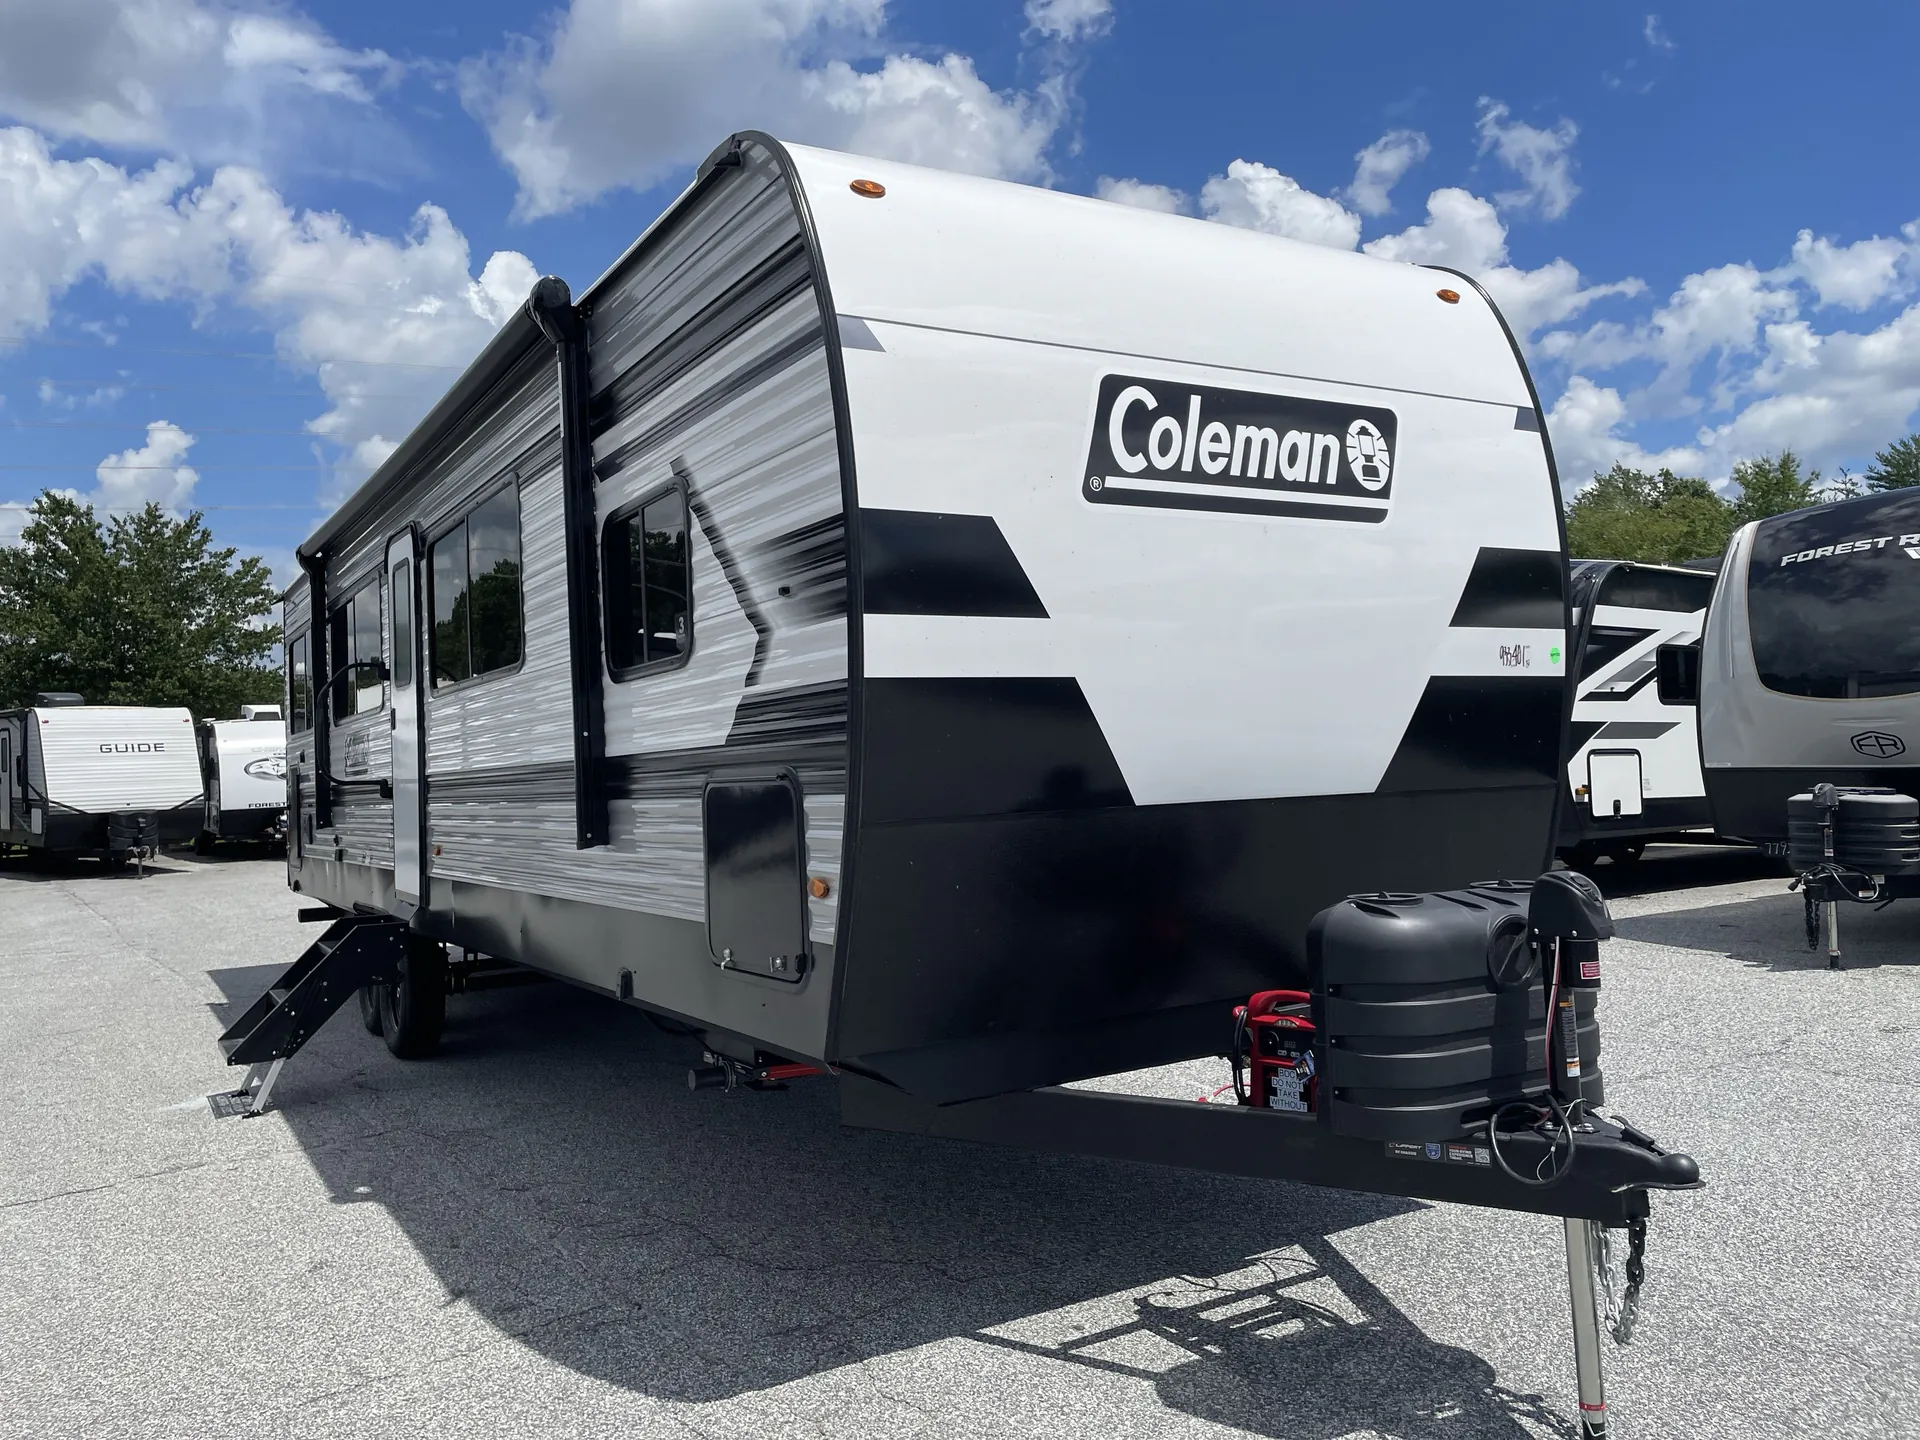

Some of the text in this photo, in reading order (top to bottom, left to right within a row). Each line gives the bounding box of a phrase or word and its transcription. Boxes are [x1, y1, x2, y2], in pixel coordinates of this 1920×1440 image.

[1109, 385, 1340, 485] Coleman
[1780, 536, 1894, 567] FOREST
[100, 743, 165, 754] GUIDE
[1279, 1068, 1296, 1079] BDC
[1272, 1077, 1303, 1091] DO NOT
[1278, 1089, 1299, 1100] TAKE
[1270, 1097, 1307, 1111] WITHOUT
